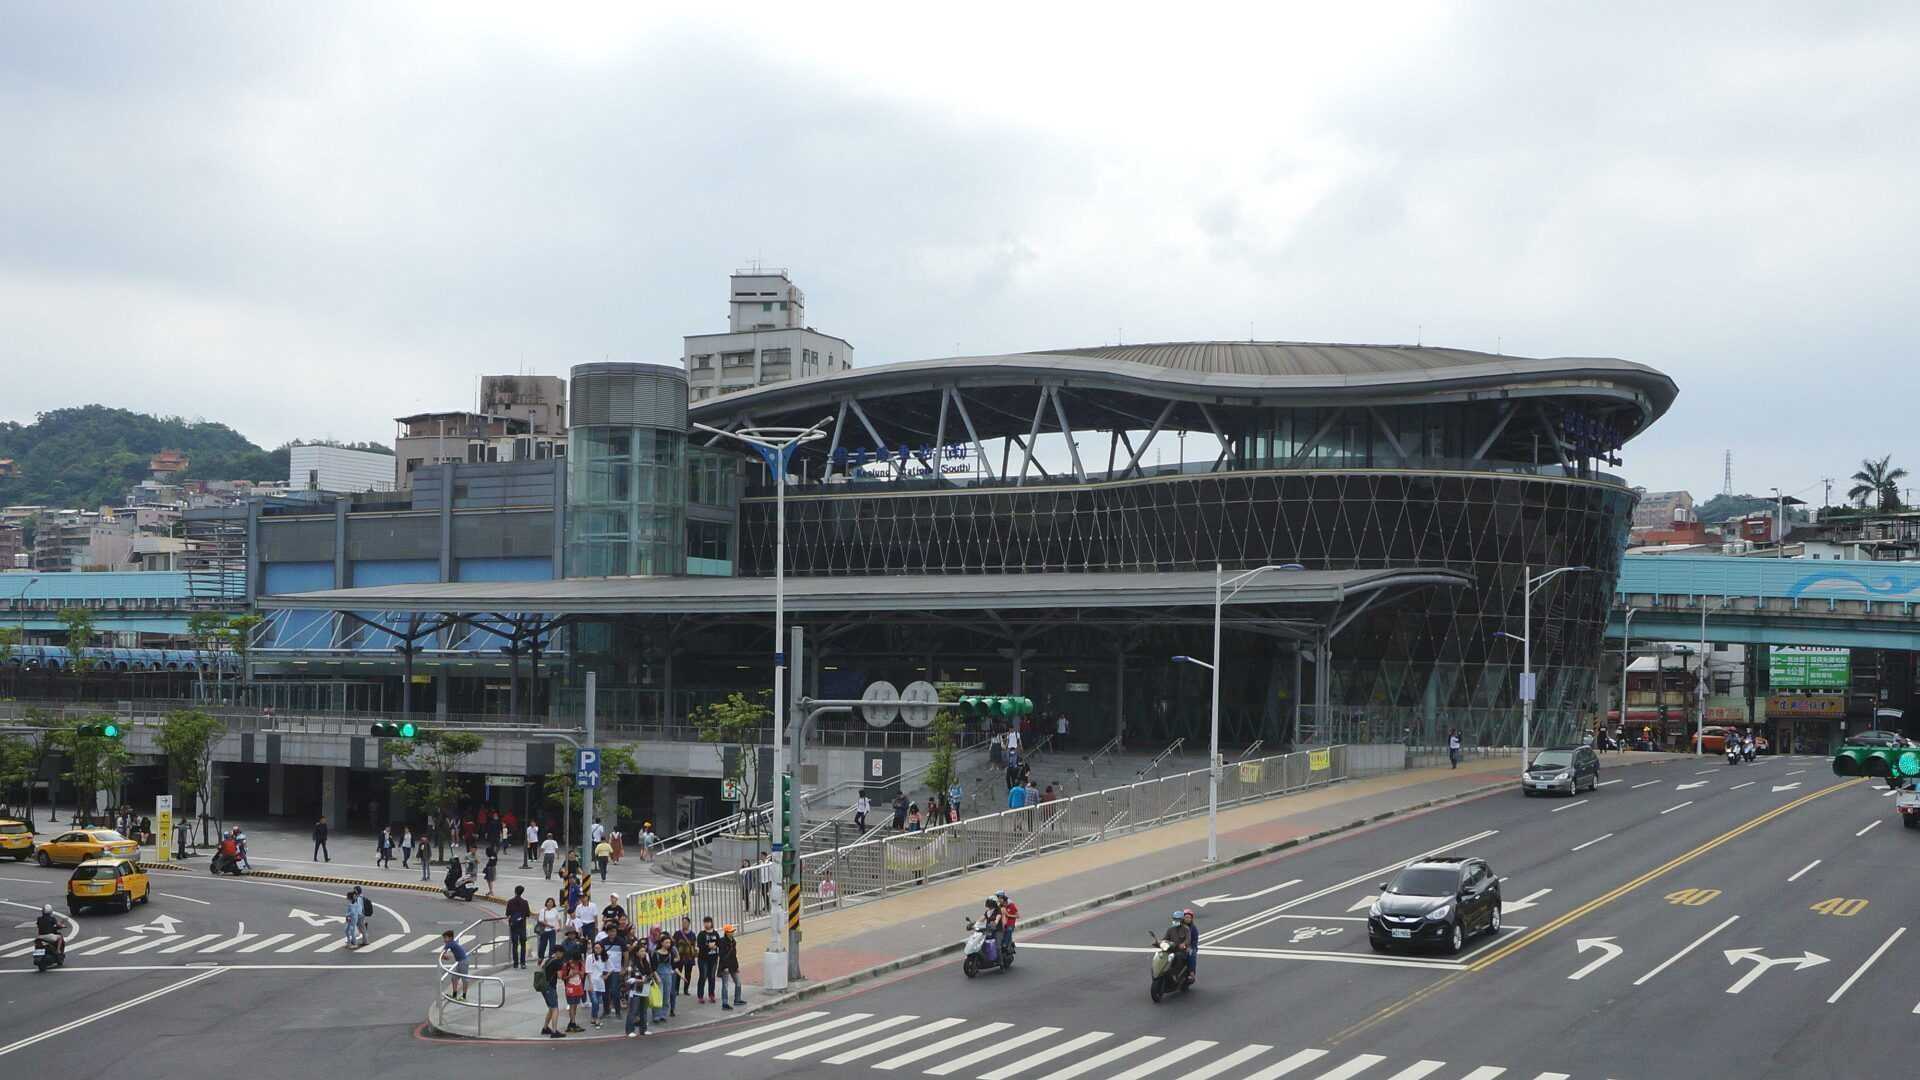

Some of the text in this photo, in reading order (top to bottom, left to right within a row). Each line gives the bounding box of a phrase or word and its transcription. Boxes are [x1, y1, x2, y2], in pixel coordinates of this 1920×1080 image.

[581, 751, 596, 770] P
[1664, 888, 1723, 906] 40
[1809, 897, 1869, 917] 40
